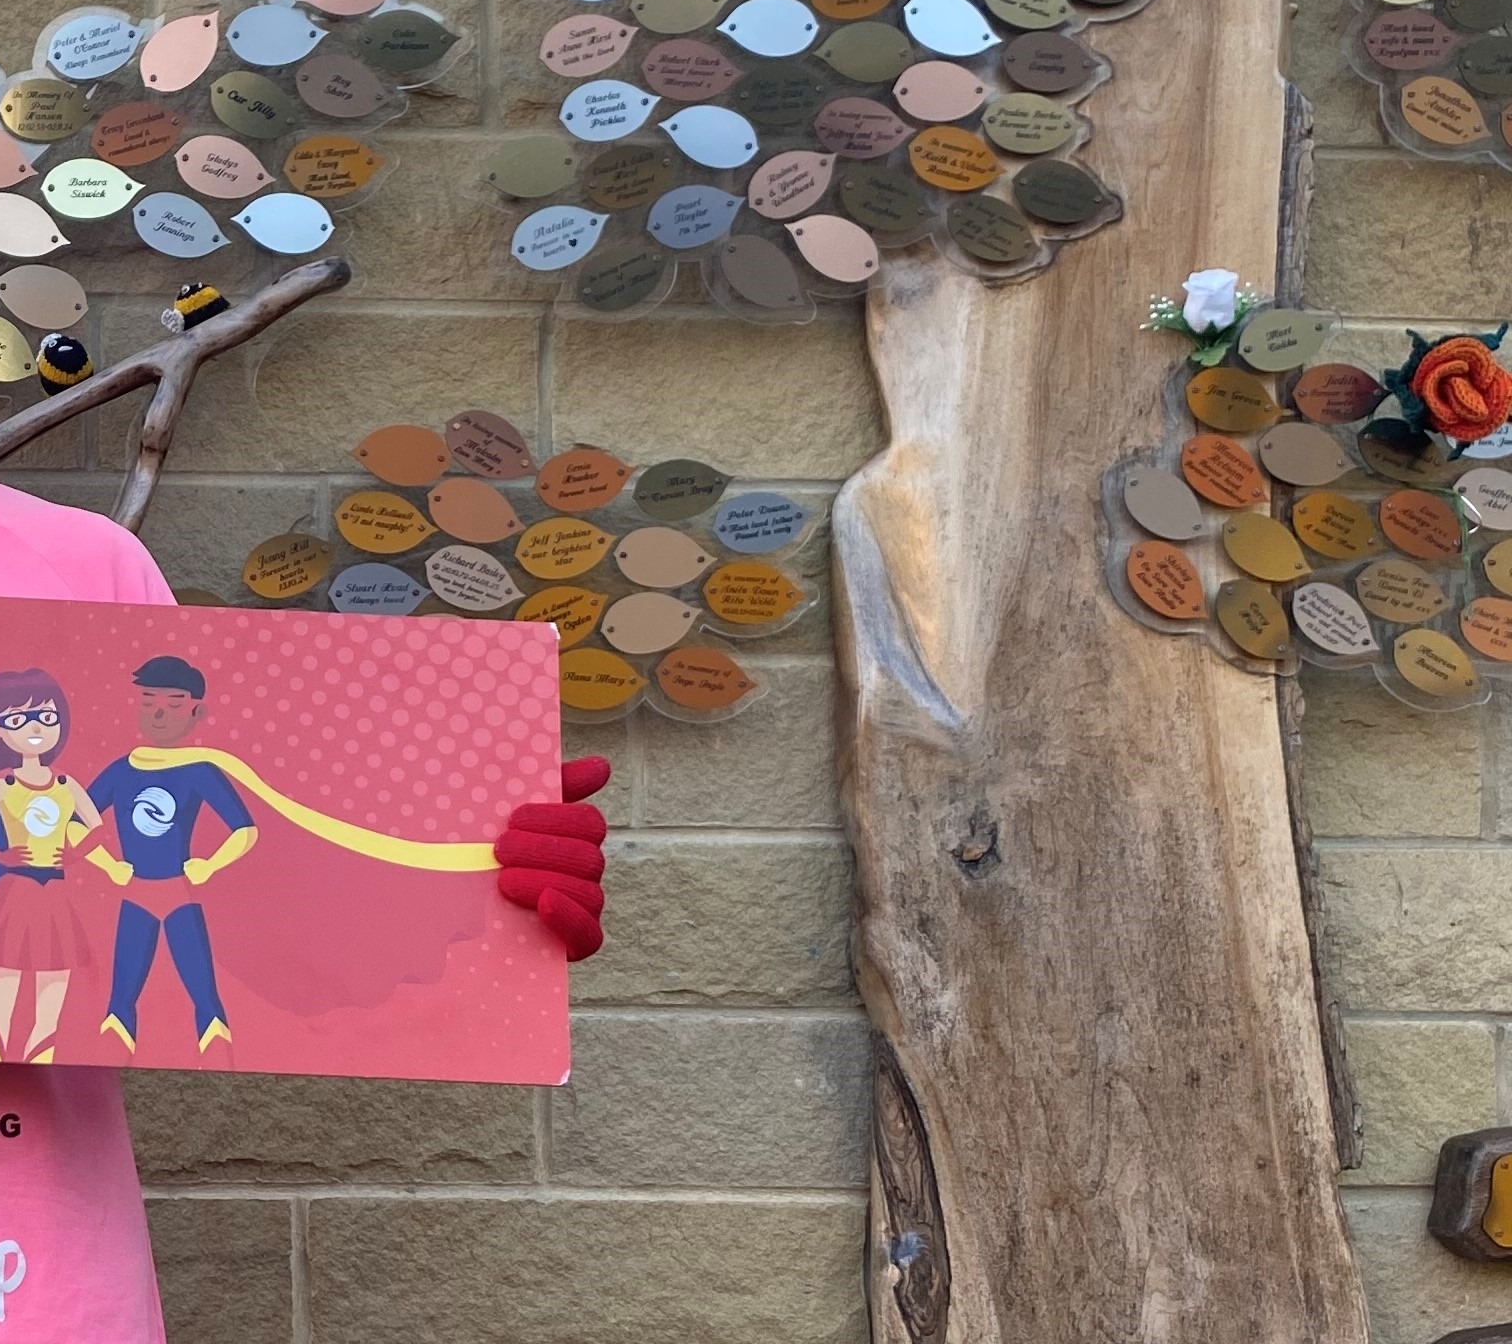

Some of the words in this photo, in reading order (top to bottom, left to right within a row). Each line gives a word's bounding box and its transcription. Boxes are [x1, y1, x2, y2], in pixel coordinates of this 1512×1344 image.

[53, 35, 77, 50] Peter
[79, 32, 87, 41] &
[88, 22, 121, 39] Muriel
[584, 91, 621, 105] Charles
[206, 152, 239, 169] Gladys
[68, 177, 108, 187] Barbara
[200, 164, 239, 182] Godfrey
[161, 210, 196, 228] Robert
[152, 221, 195, 242] Jennings
[533, 217, 575, 240] Natalia
[440, 550, 476, 570] Richard
[344, 583, 377, 593] Stuart
